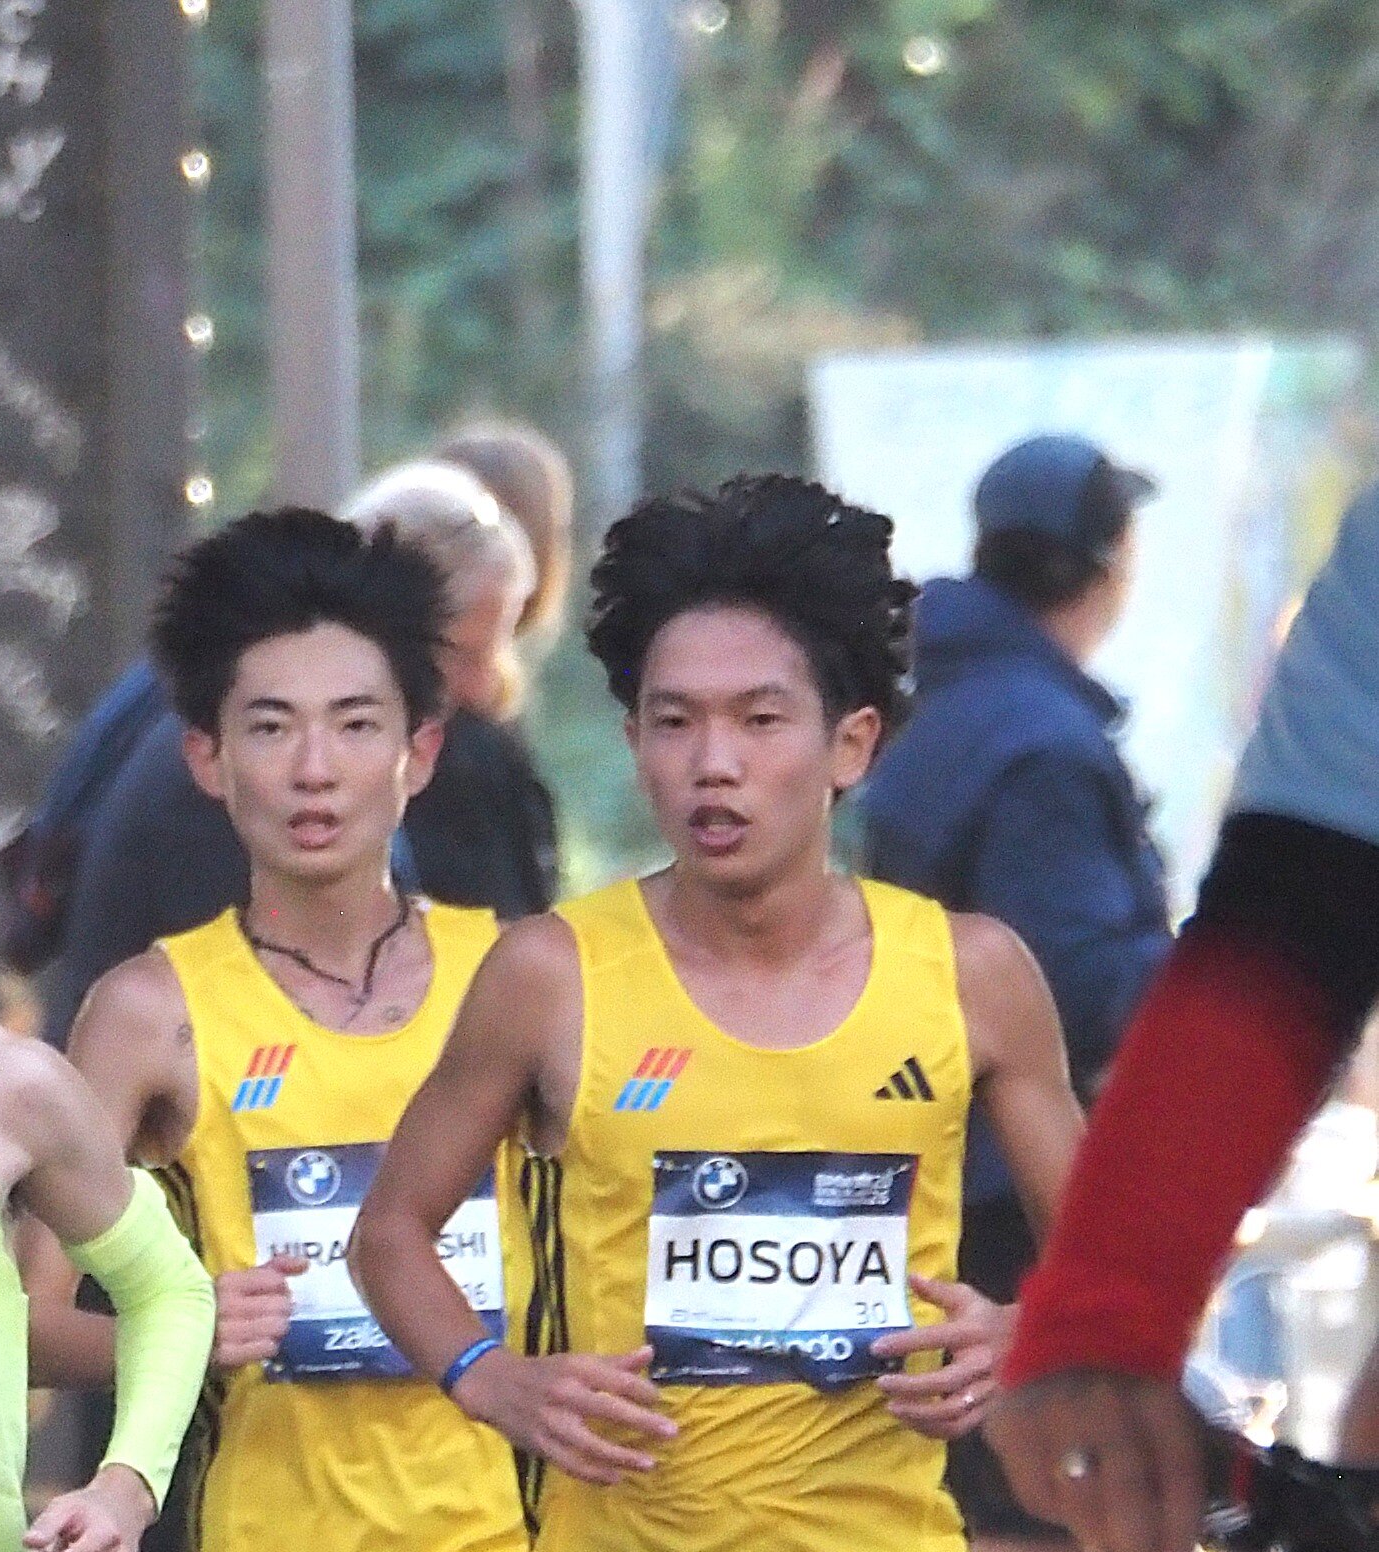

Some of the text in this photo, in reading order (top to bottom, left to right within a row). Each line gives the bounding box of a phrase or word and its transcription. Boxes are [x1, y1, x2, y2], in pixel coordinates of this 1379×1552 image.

[664, 1237, 892, 1286] HOSOYA
[854, 1301, 888, 1325] 30
[324, 1325, 392, 1351] zala
